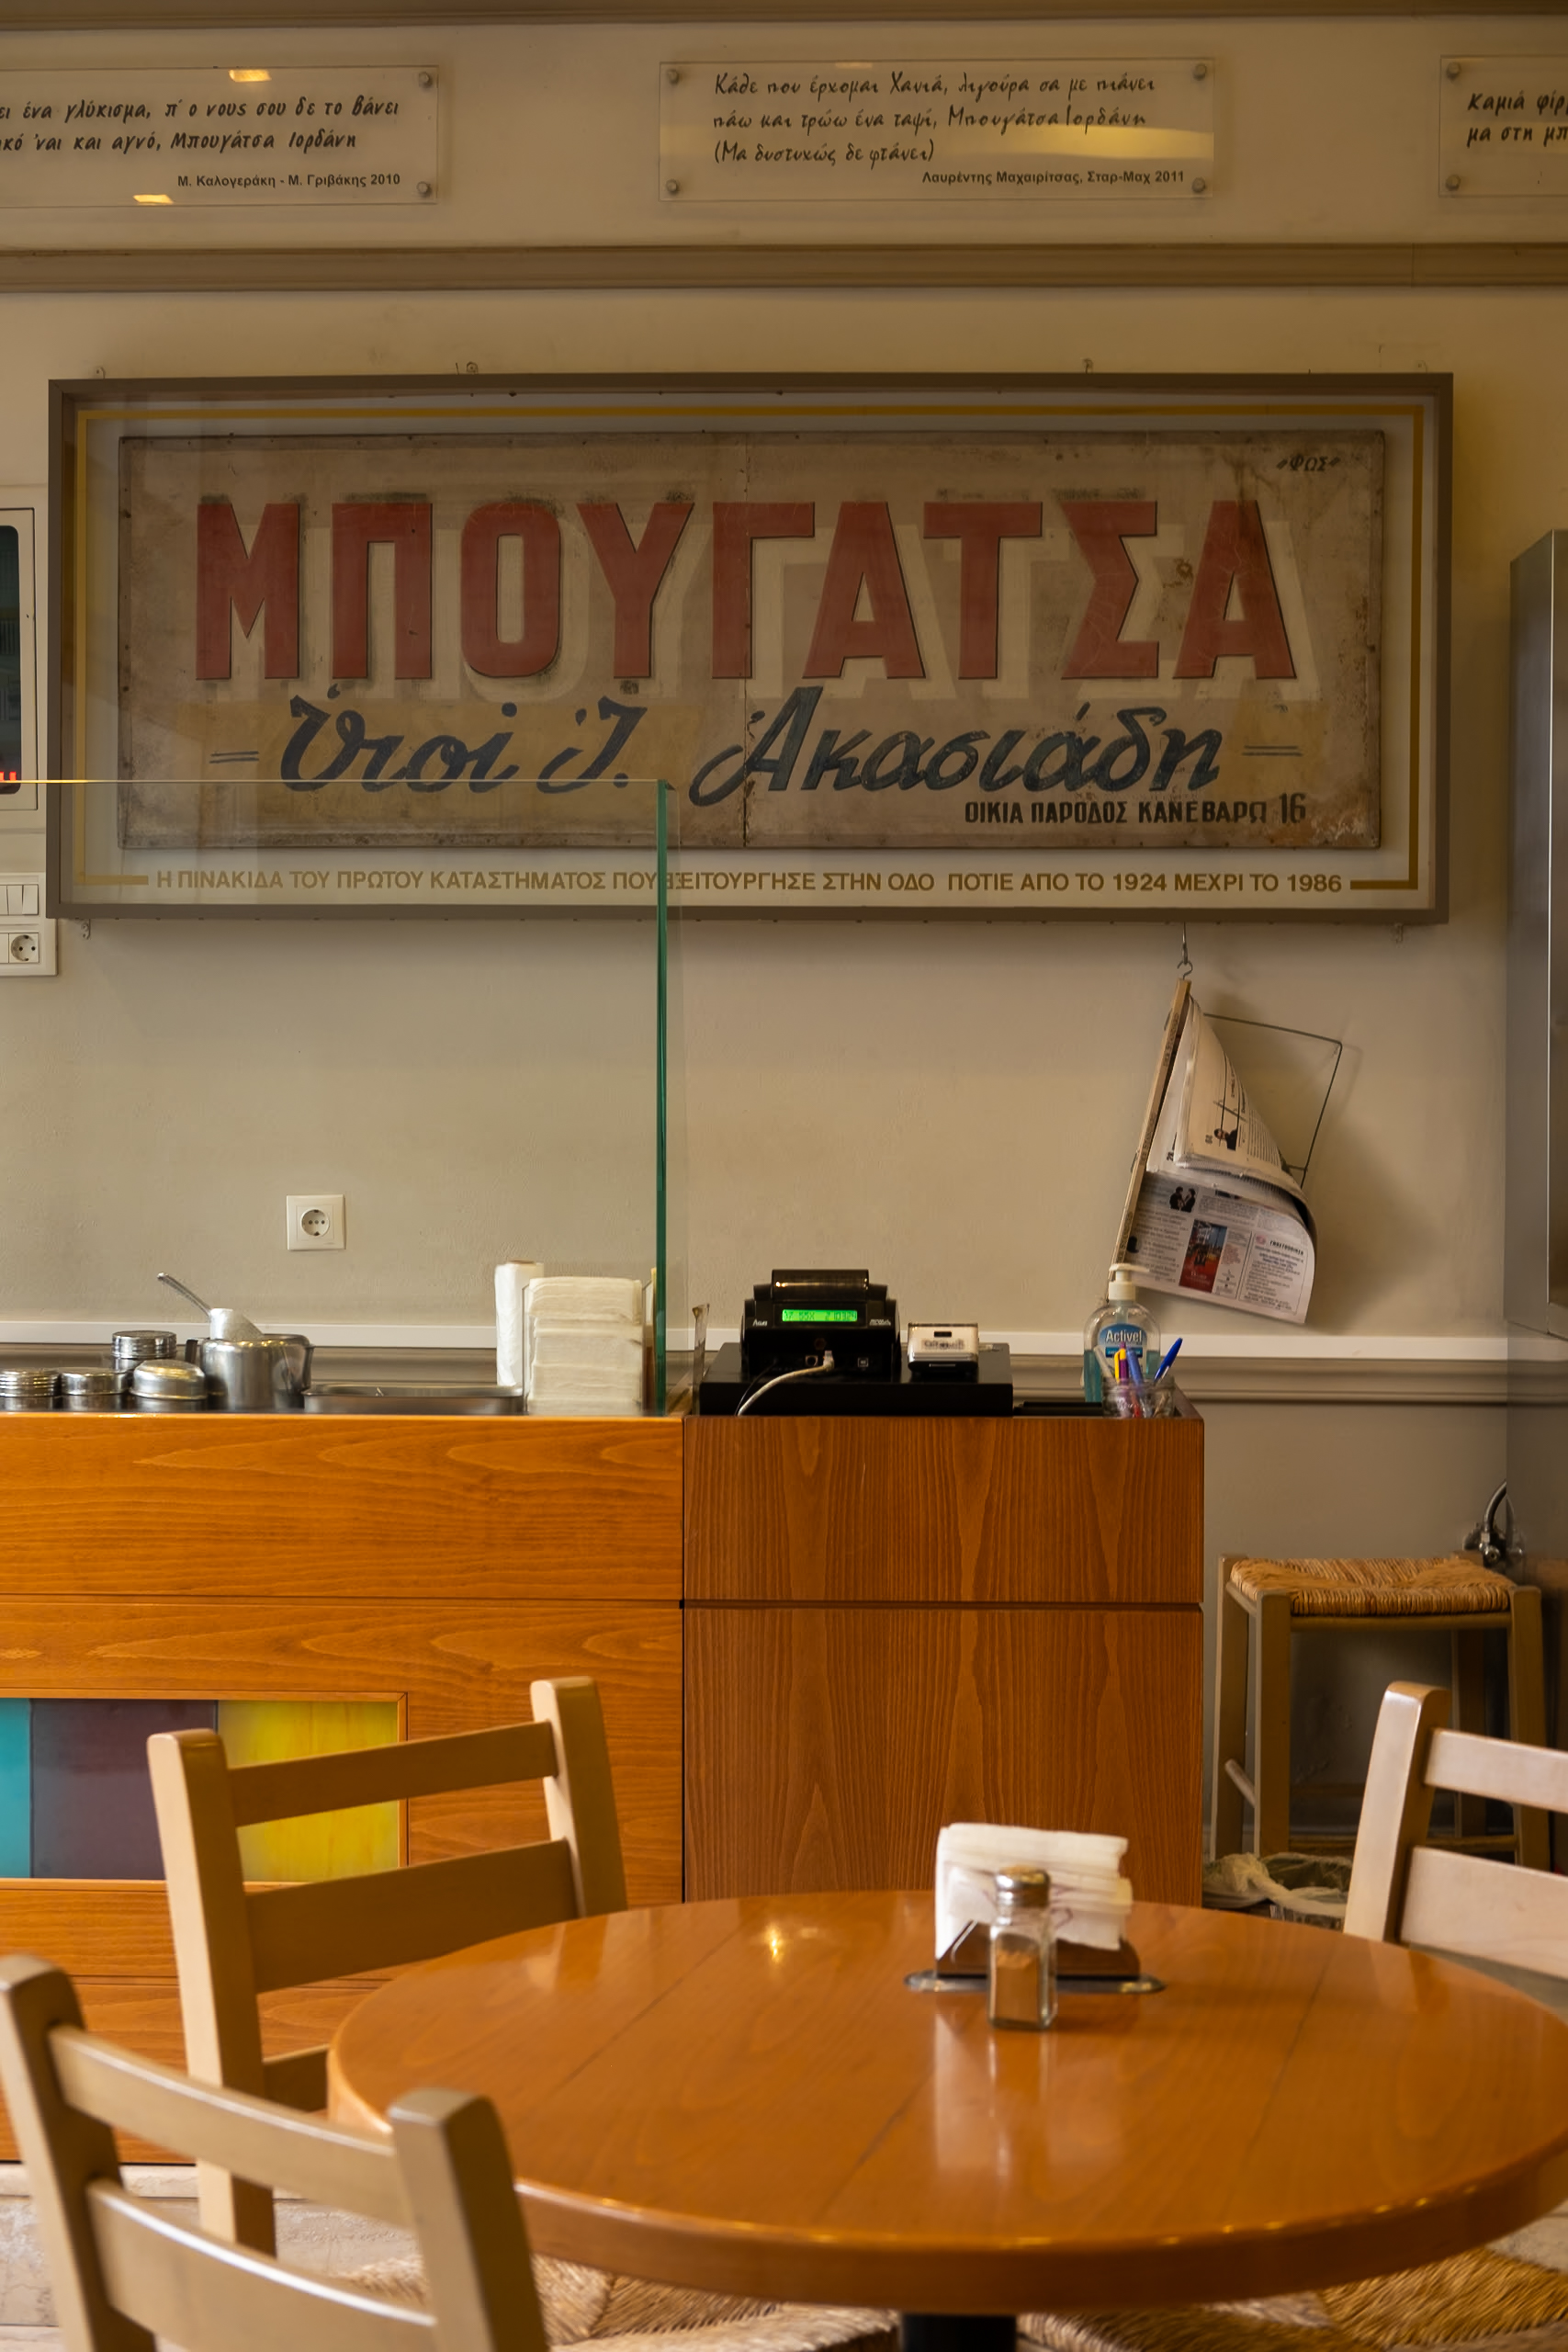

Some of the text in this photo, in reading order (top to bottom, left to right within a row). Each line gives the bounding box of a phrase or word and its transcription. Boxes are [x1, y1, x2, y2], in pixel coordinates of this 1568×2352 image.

[715, 71, 1155, 103] Κάθε που έρχομαι Χανιά, λιγούρα σα με πιάνει
[22, 101, 52, 119] ένα
[64, 99, 151, 124] γλύκισμα,
[188, 103, 197, 117] ο
[206, 103, 247, 117] νους
[255, 102, 287, 116] σου
[294, 96, 316, 116] δε
[324, 102, 343, 115] το
[351, 95, 399, 117] βάνει
[1467, 89, 1568, 117] Καμιά φίρ
[714, 104, 1146, 137] πάω και τρώω ένα ταψί, Μπουγάτσα Ιορδάνη
[73, 136, 101, 150] και
[111, 131, 162, 154] αγνό,
[170, 130, 275, 154] Μπουγάτσα
[288, 128, 356, 154] Ιορδάνη
[1466, 127, 1491, 148] μα
[1501, 127, 1533, 141] στη
[715, 139, 934, 171] (Μα δυστυχώς δε φτάνει)
[177, 175, 192, 187] Μ.
[196, 175, 276, 189] Καλογεράκη
[288, 175, 302, 186] Μ.
[307, 175, 367, 188] Γριβάκης
[370, 174, 400, 186] 2010
[921, 170, 1184, 187] Λαυρέντης Μαχαιρίτσας, Σταρ-Μαχ 2011
[195, 501, 1297, 681] ΜΠΟΥΓΑΤΣΑ
[964, 801, 1023, 823] ΟΙΚΙΑ
[1032, 800, 1128, 823] ΠΑΡΟΔΟΣ
[1279, 792, 1307, 824] 16
[157, 871, 172, 888] Η
[177, 871, 284, 888] ΠΙΝΑΚΙΔΑ
[289, 871, 329, 889] ΤΟΥ
[337, 871, 423, 889] ΠΡΩΤΟΥ
[430, 871, 605, 890] ΚΑΤΑΣΤΗΜΑΤΟΣ
[614, 872, 657, 889] ΠΟΥ
[823, 872, 881, 890] ΣΤΗΝ
[887, 873, 935, 890] ΟΔΟ
[948, 874, 1012, 890] ΠΟΤΙΕ
[1021, 874, 1069, 890] ΑΠΟ
[1076, 874, 1104, 891] ΤΟ
[1112, 874, 1167, 891] 1924
[1175, 874, 1243, 891] ΜΕΧΡΙ
[1250, 874, 1279, 892] ΤΟ
[1287, 875, 1342, 892] 1986
